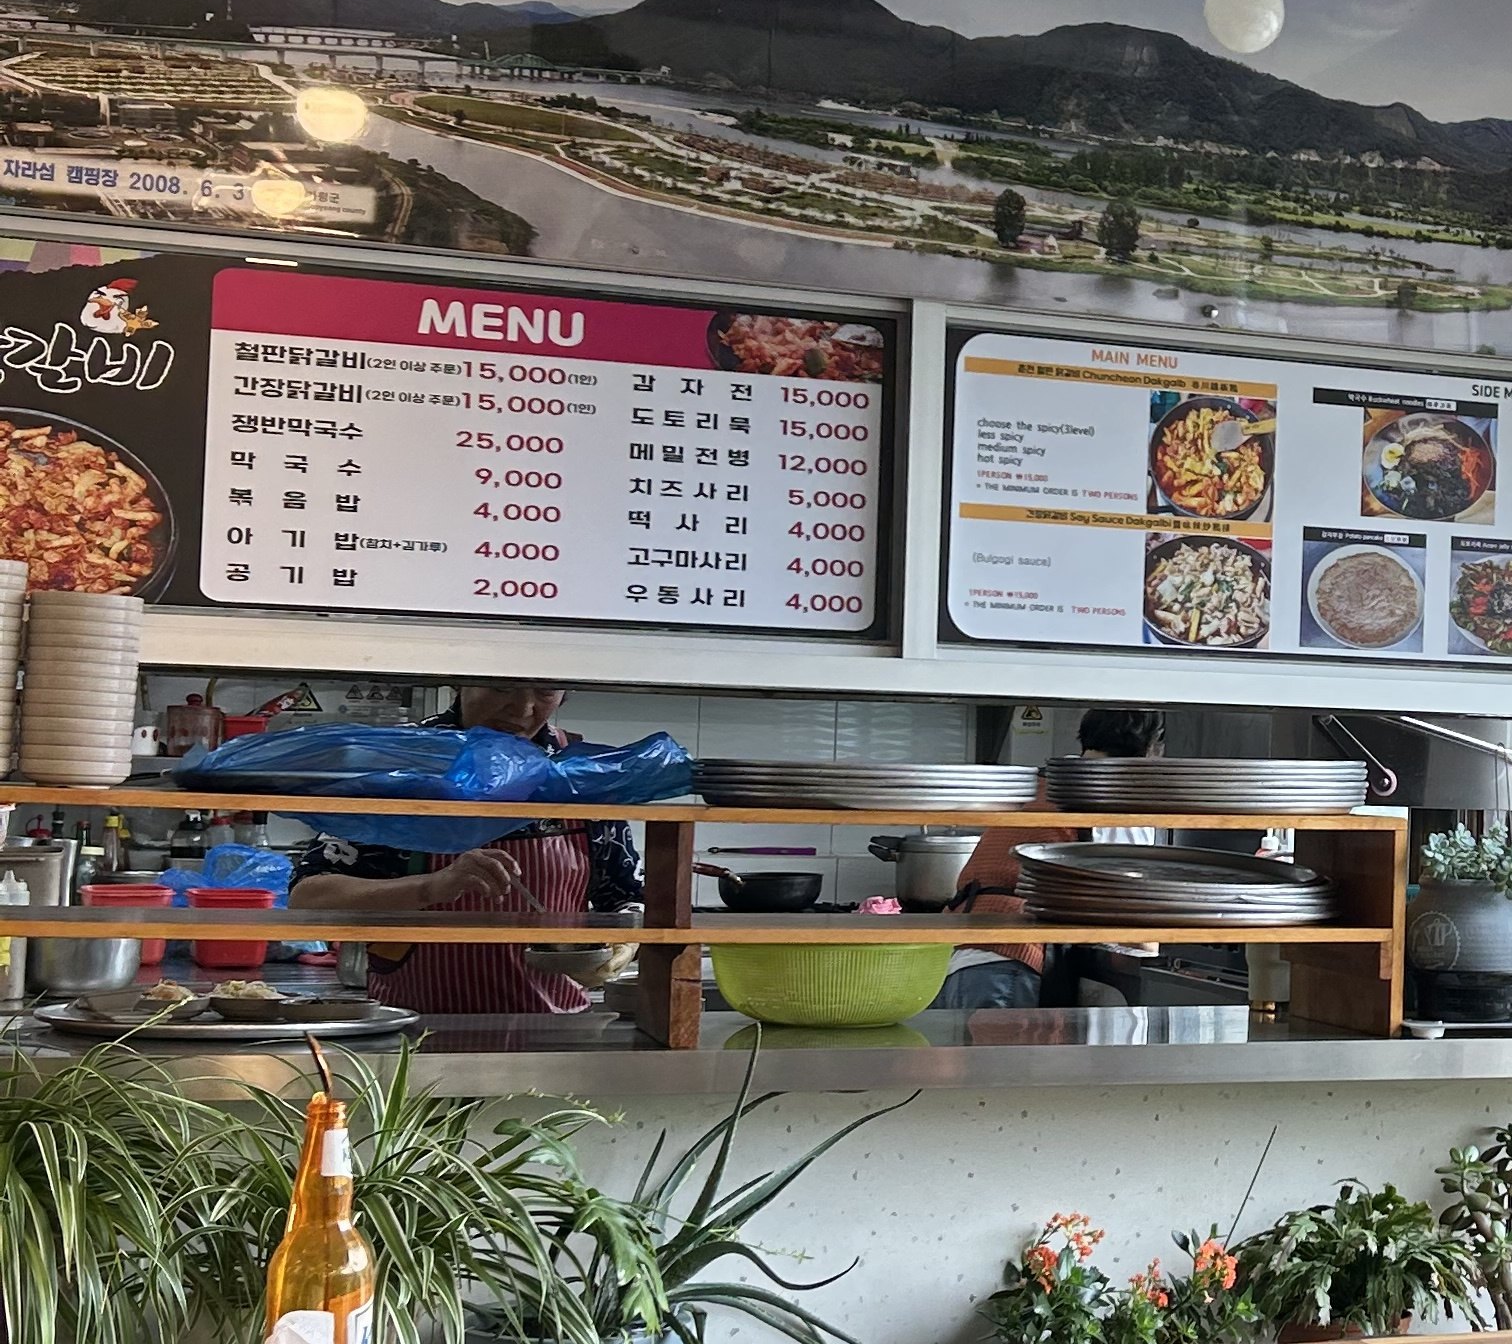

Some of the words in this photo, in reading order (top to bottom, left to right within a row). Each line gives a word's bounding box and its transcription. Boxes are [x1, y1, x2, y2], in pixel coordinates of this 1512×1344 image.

[3, 158, 56, 182] 자라섬
[66, 165, 120, 188] 캠핑장
[129, 171, 188, 195] 2008.
[416, 298, 586, 348] MENU
[0, 321, 175, 394] 갈비
[234, 341, 367, 371] 철판닭갈비
[399, 359, 428, 374] 이상
[462, 360, 567, 387] 15,000
[1091, 348, 1130, 366] MAIN
[1136, 352, 1179, 370] MENU
[233, 375, 364, 405] 간장닭갈비
[398, 390, 427, 406] 이상
[461, 391, 567, 418] 15,000
[780, 386, 870, 411] 15,000
[1471, 383, 1500, 399] SIDE
[230, 413, 364, 442] 쟁반막국수
[455, 430, 565, 456] 25,000
[630, 406, 752, 436] 도토리묵
[778, 419, 869, 443] 15,000
[976, 417, 1012, 431] choose
[1016, 420, 1034, 432] the
[976, 430, 997, 442] less
[1000, 432, 1025, 444] spicy
[629, 442, 751, 468] 메밀전병
[777, 453, 868, 477] 12,000
[976, 442, 1018, 455] medium
[1022, 444, 1047, 458] spicy
[976, 453, 995, 464] hot
[998, 455, 1024, 468] spicy
[474, 467, 564, 490] 9,000
[628, 476, 749, 503] 치즈사리
[787, 488, 867, 511] 5,000
[472, 501, 562, 524] 4,000
[1069, 512, 1091, 525] Soy
[1091, 514, 1125, 526] Sauce
[787, 521, 866, 543] 4,000
[473, 540, 561, 563] 4,000
[626, 546, 748, 572] 고구마사리
[785, 556, 865, 578] 4,000
[1018, 555, 1052, 569] sauce)
[472, 578, 559, 599] 2,000
[624, 584, 746, 608] 우동사리
[784, 592, 864, 614] 4,000
